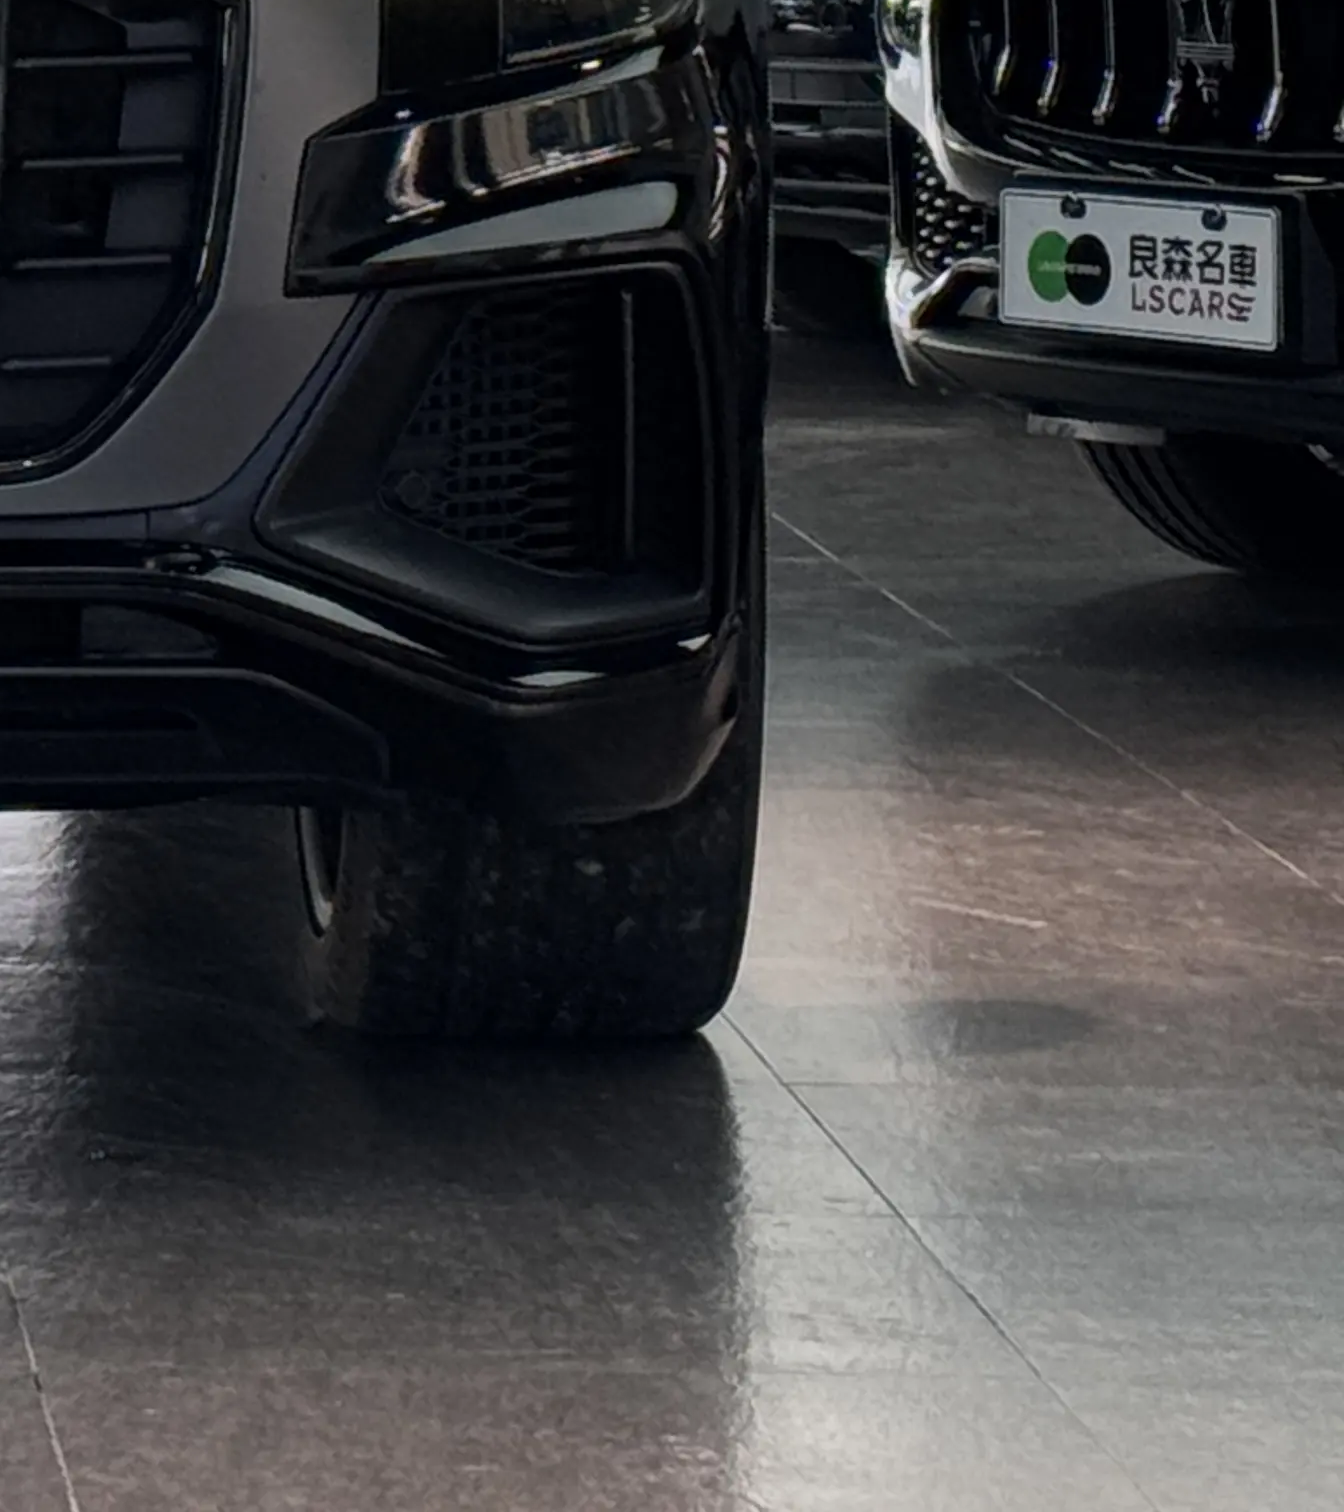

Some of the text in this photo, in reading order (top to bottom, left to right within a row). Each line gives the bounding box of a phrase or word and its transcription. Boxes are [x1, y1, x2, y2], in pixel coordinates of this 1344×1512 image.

[1128, 234, 1257, 287] 良森名車
[1131, 283, 1255, 322] LSCARS
